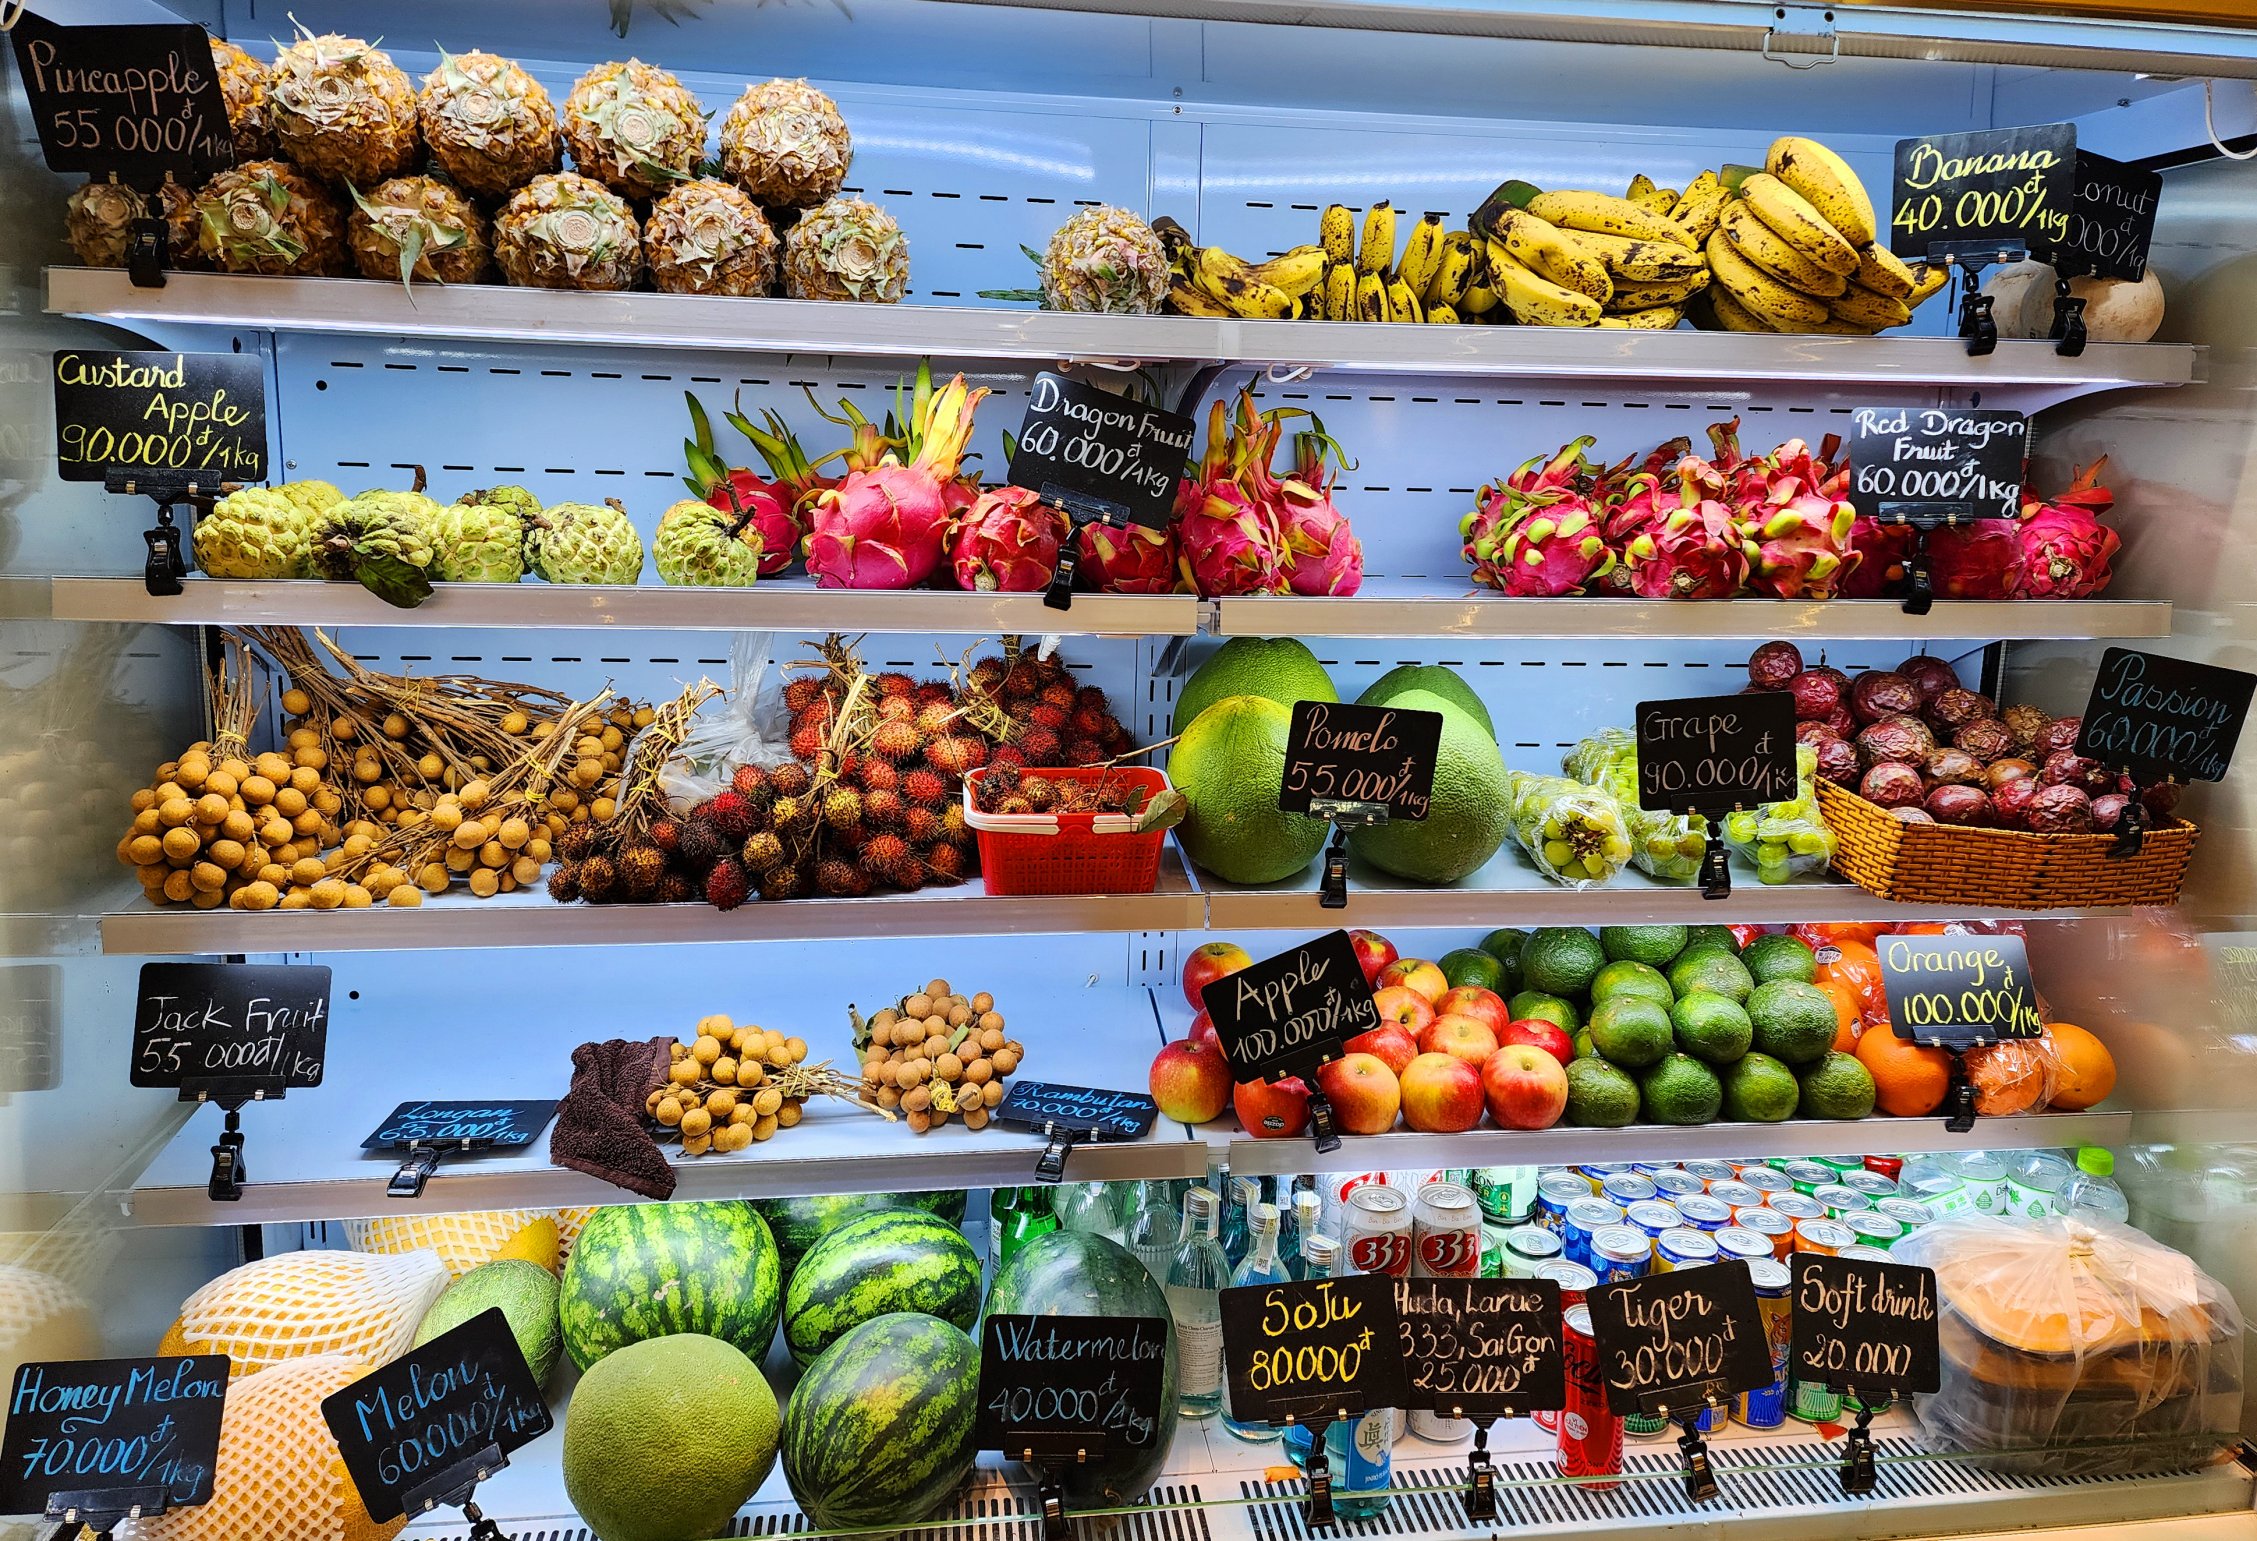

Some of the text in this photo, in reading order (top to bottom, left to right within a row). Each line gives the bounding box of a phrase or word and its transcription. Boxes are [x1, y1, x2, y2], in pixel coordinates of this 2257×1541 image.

[28, 40, 209, 116] Pineapple
[1904, 143, 2061, 190] Banana
[57, 353, 188, 389] Custard
[143, 388, 250, 435] Apple
[1030, 377, 1194, 450] Dragon Fruit
[1855, 409, 2025, 450] Red Dragon
[1892, 436, 1959, 462] Fruit
[2101, 653, 2233, 725] Passion
[1304, 703, 1399, 754] Pomelo
[1644, 711, 1743, 754] Grape
[1236, 950, 1331, 1024] Apple
[1888, 941, 2005, 987] Orange
[140, 996, 326, 1034] Jack Fruit
[398, 1101, 526, 1130] Longan
[1012, 1082, 1153, 1111] Rambutan
[1357, 1231, 1406, 1273] 333
[1427, 1228, 1475, 1269] 333
[1465, 1284, 1545, 1315] Larue
[1608, 1283, 1713, 1353] Tiger
[1800, 1264, 1935, 1330] Soft drink
[995, 1314, 1166, 1363] Watermelon
[12, 1358, 225, 1435] Honey Melon
[355, 1360, 479, 1444] Melon
